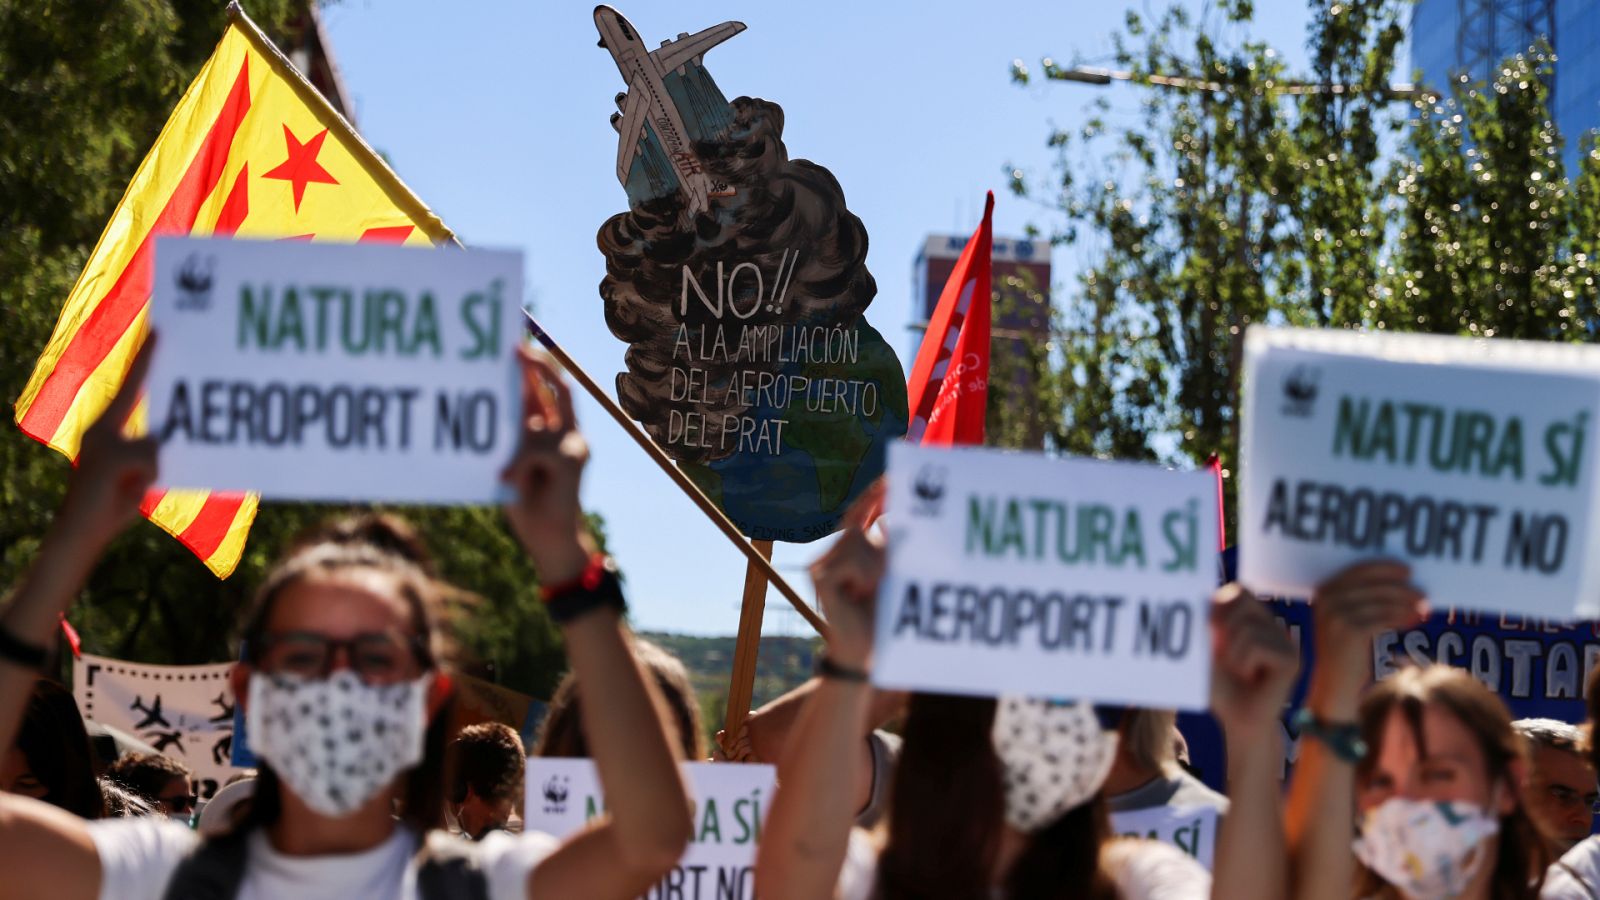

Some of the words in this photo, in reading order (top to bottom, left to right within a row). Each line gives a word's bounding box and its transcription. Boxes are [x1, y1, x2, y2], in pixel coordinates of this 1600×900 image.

[237, 284, 445, 360] NATURA
[459, 276, 505, 361] SÍ
[680, 248, 799, 319] NO!!
[673, 322, 692, 361] A
[700, 324, 728, 361] LA
[735, 323, 859, 364] AMPLIACIÓN
[159, 378, 420, 450] AEROPORT
[434, 386, 498, 454] NO
[670, 367, 715, 405] DEL
[724, 370, 877, 417] AEROPUERTO
[668, 409, 713, 448] DEL
[721, 414, 789, 456] PRAT
[1333, 394, 1526, 482] NATURA
[1538, 410, 1590, 488] SÍ
[752, 526, 795, 540] FLYING
[803, 520, 834, 538] SAVE
[965, 492, 1147, 570] NATURA
[1160, 496, 1202, 572] SÍ
[1262, 478, 1497, 566] AEROPORT
[1504, 510, 1569, 576] NO
[894, 580, 1125, 656] AEROPORT
[1134, 600, 1193, 661] NO
[733, 789, 762, 844] SÍ
